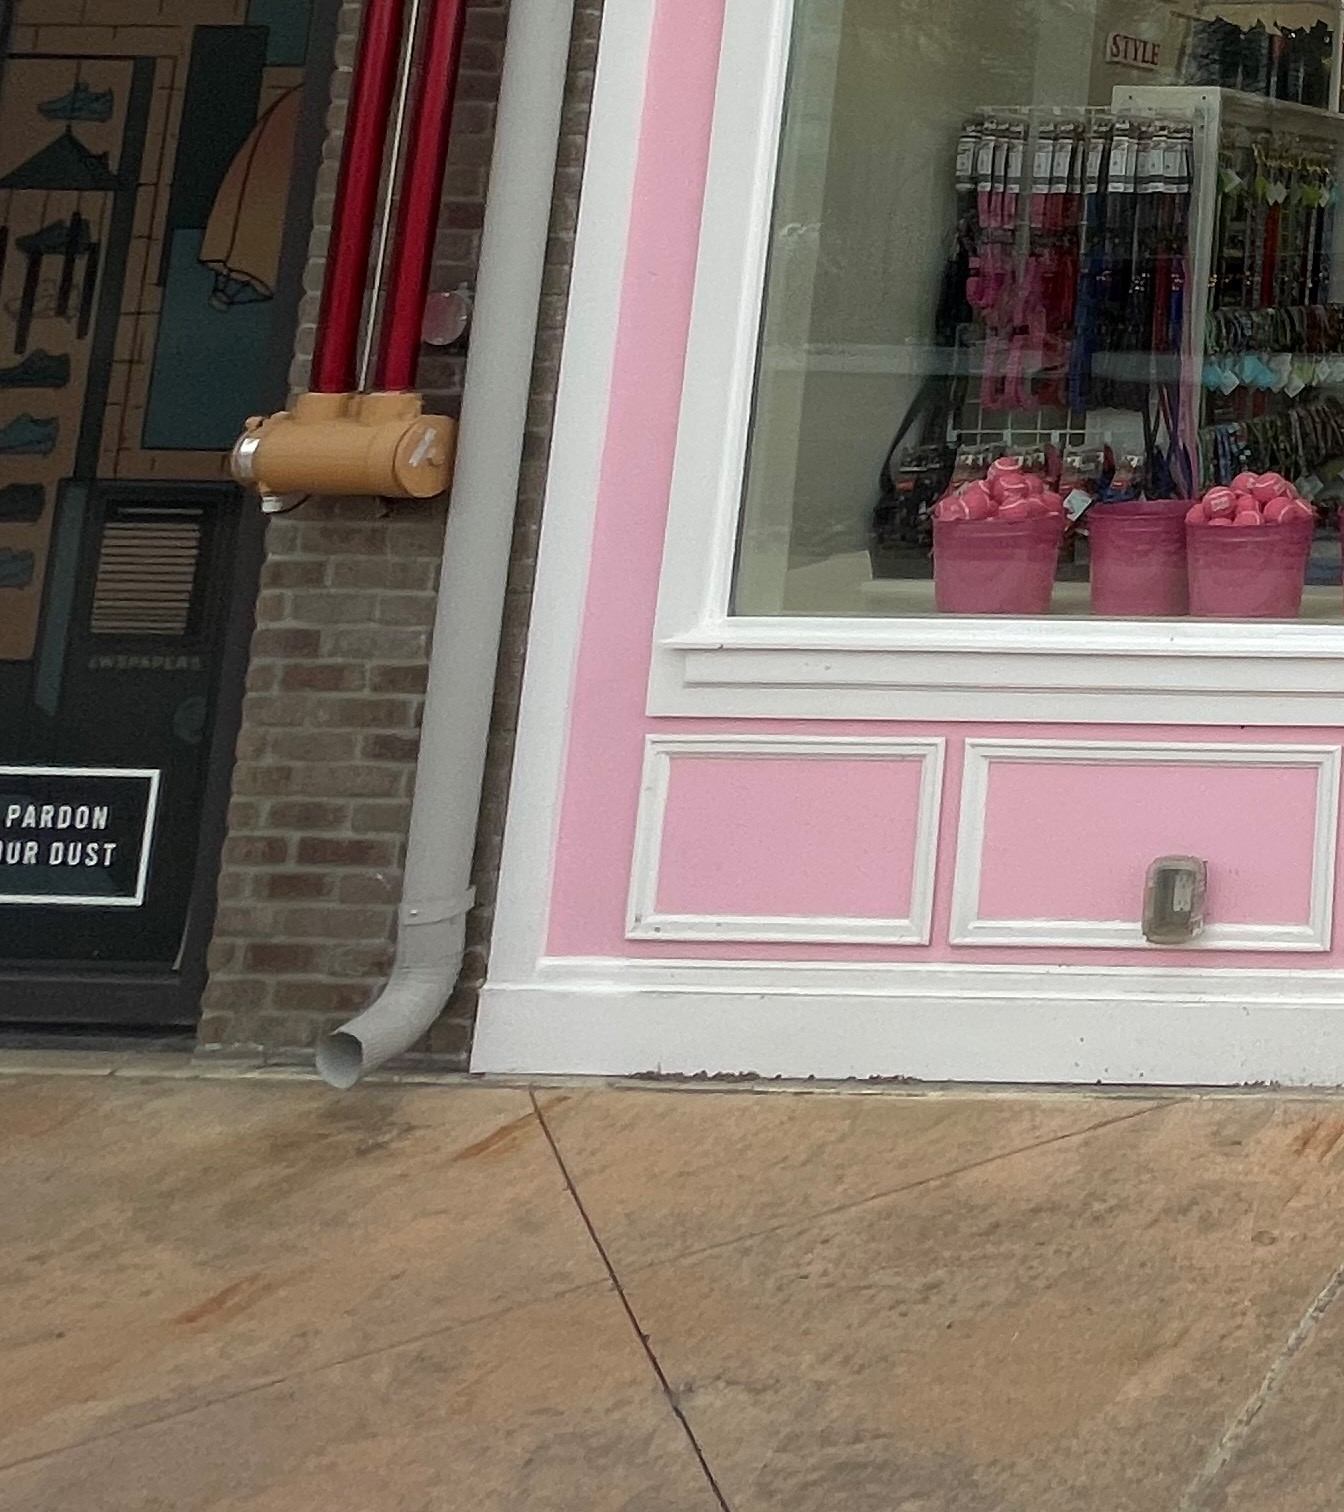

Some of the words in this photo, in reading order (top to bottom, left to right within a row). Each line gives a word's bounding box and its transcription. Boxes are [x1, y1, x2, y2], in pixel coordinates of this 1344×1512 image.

[1111, 34, 1160, 65] STYLE
[6, 804, 110, 830] PARDON
[0, 841, 39, 865] UR
[49, 842, 118, 867] DUST
